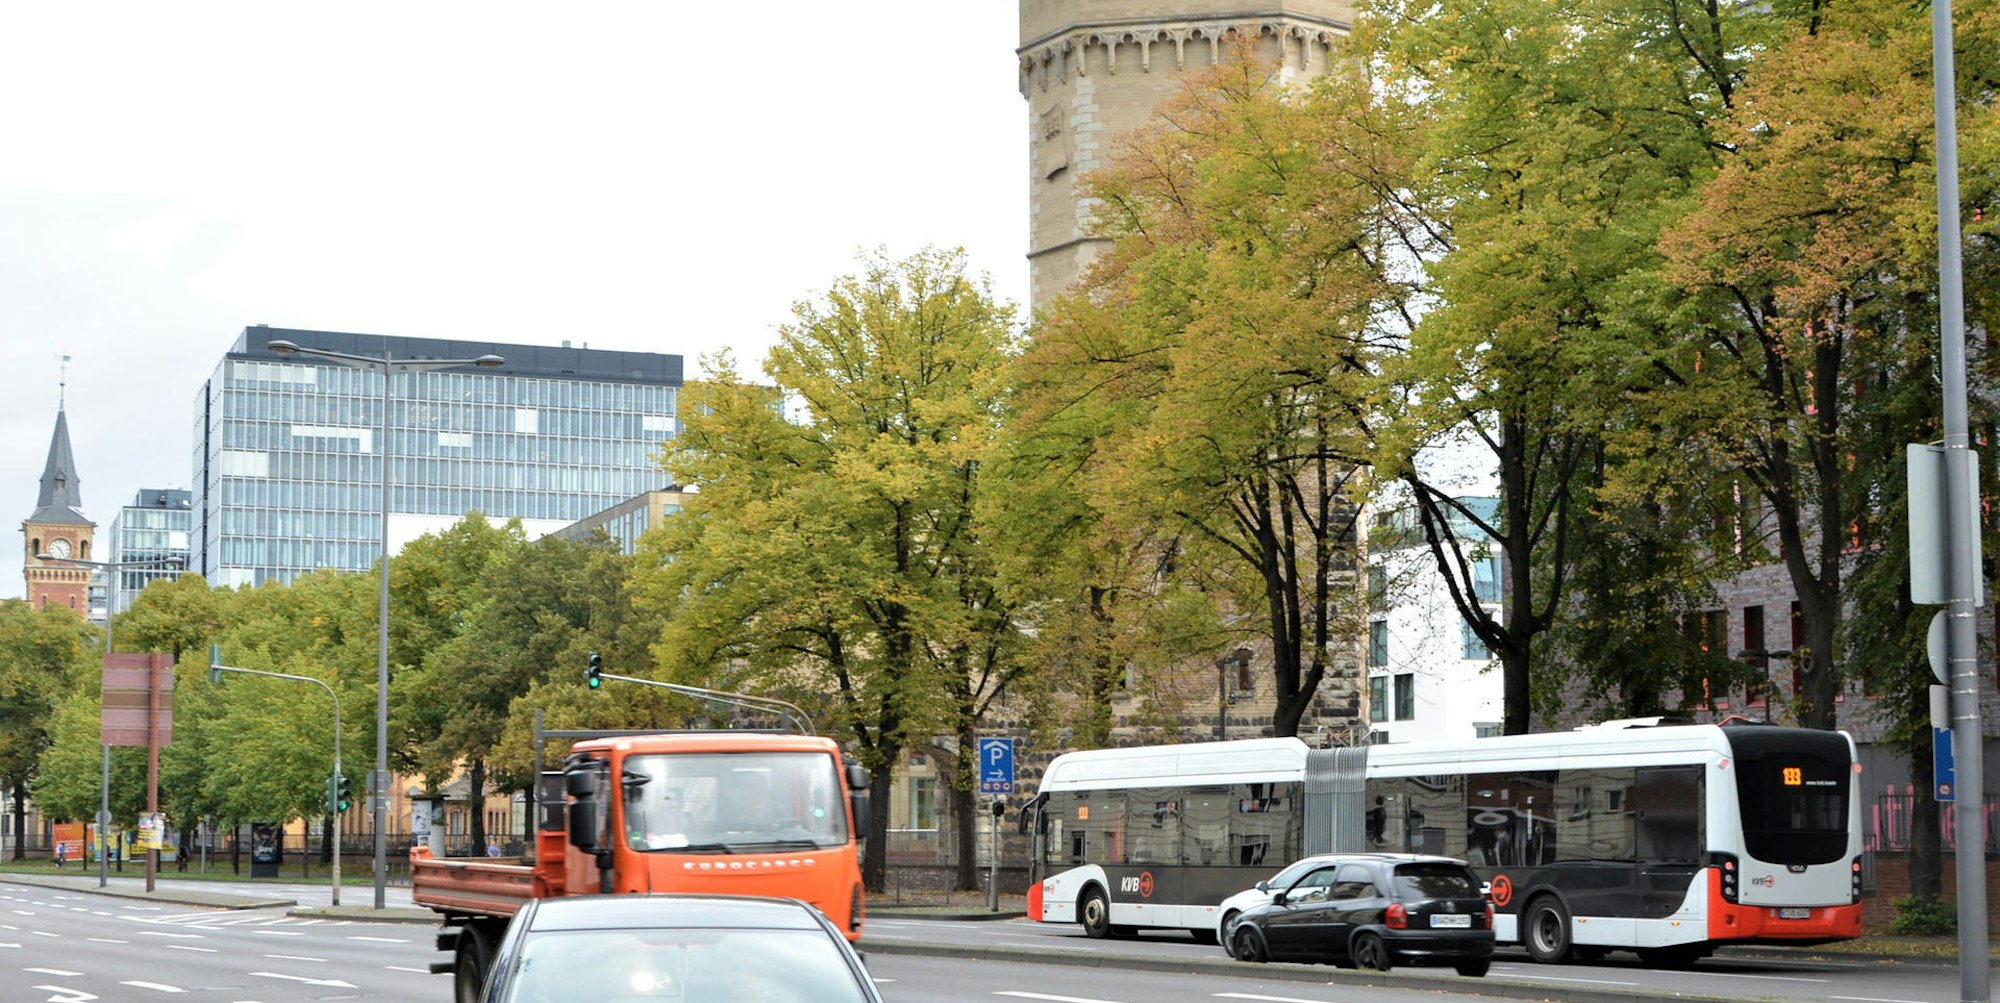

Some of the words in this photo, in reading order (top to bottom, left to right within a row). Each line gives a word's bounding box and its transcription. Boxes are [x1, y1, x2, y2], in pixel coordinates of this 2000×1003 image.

[991, 747, 1003, 766] P
[1783, 767, 1801, 785] 133
[683, 858, 816, 870] EUROCARGO
[1121, 877, 1140, 892] KVB
